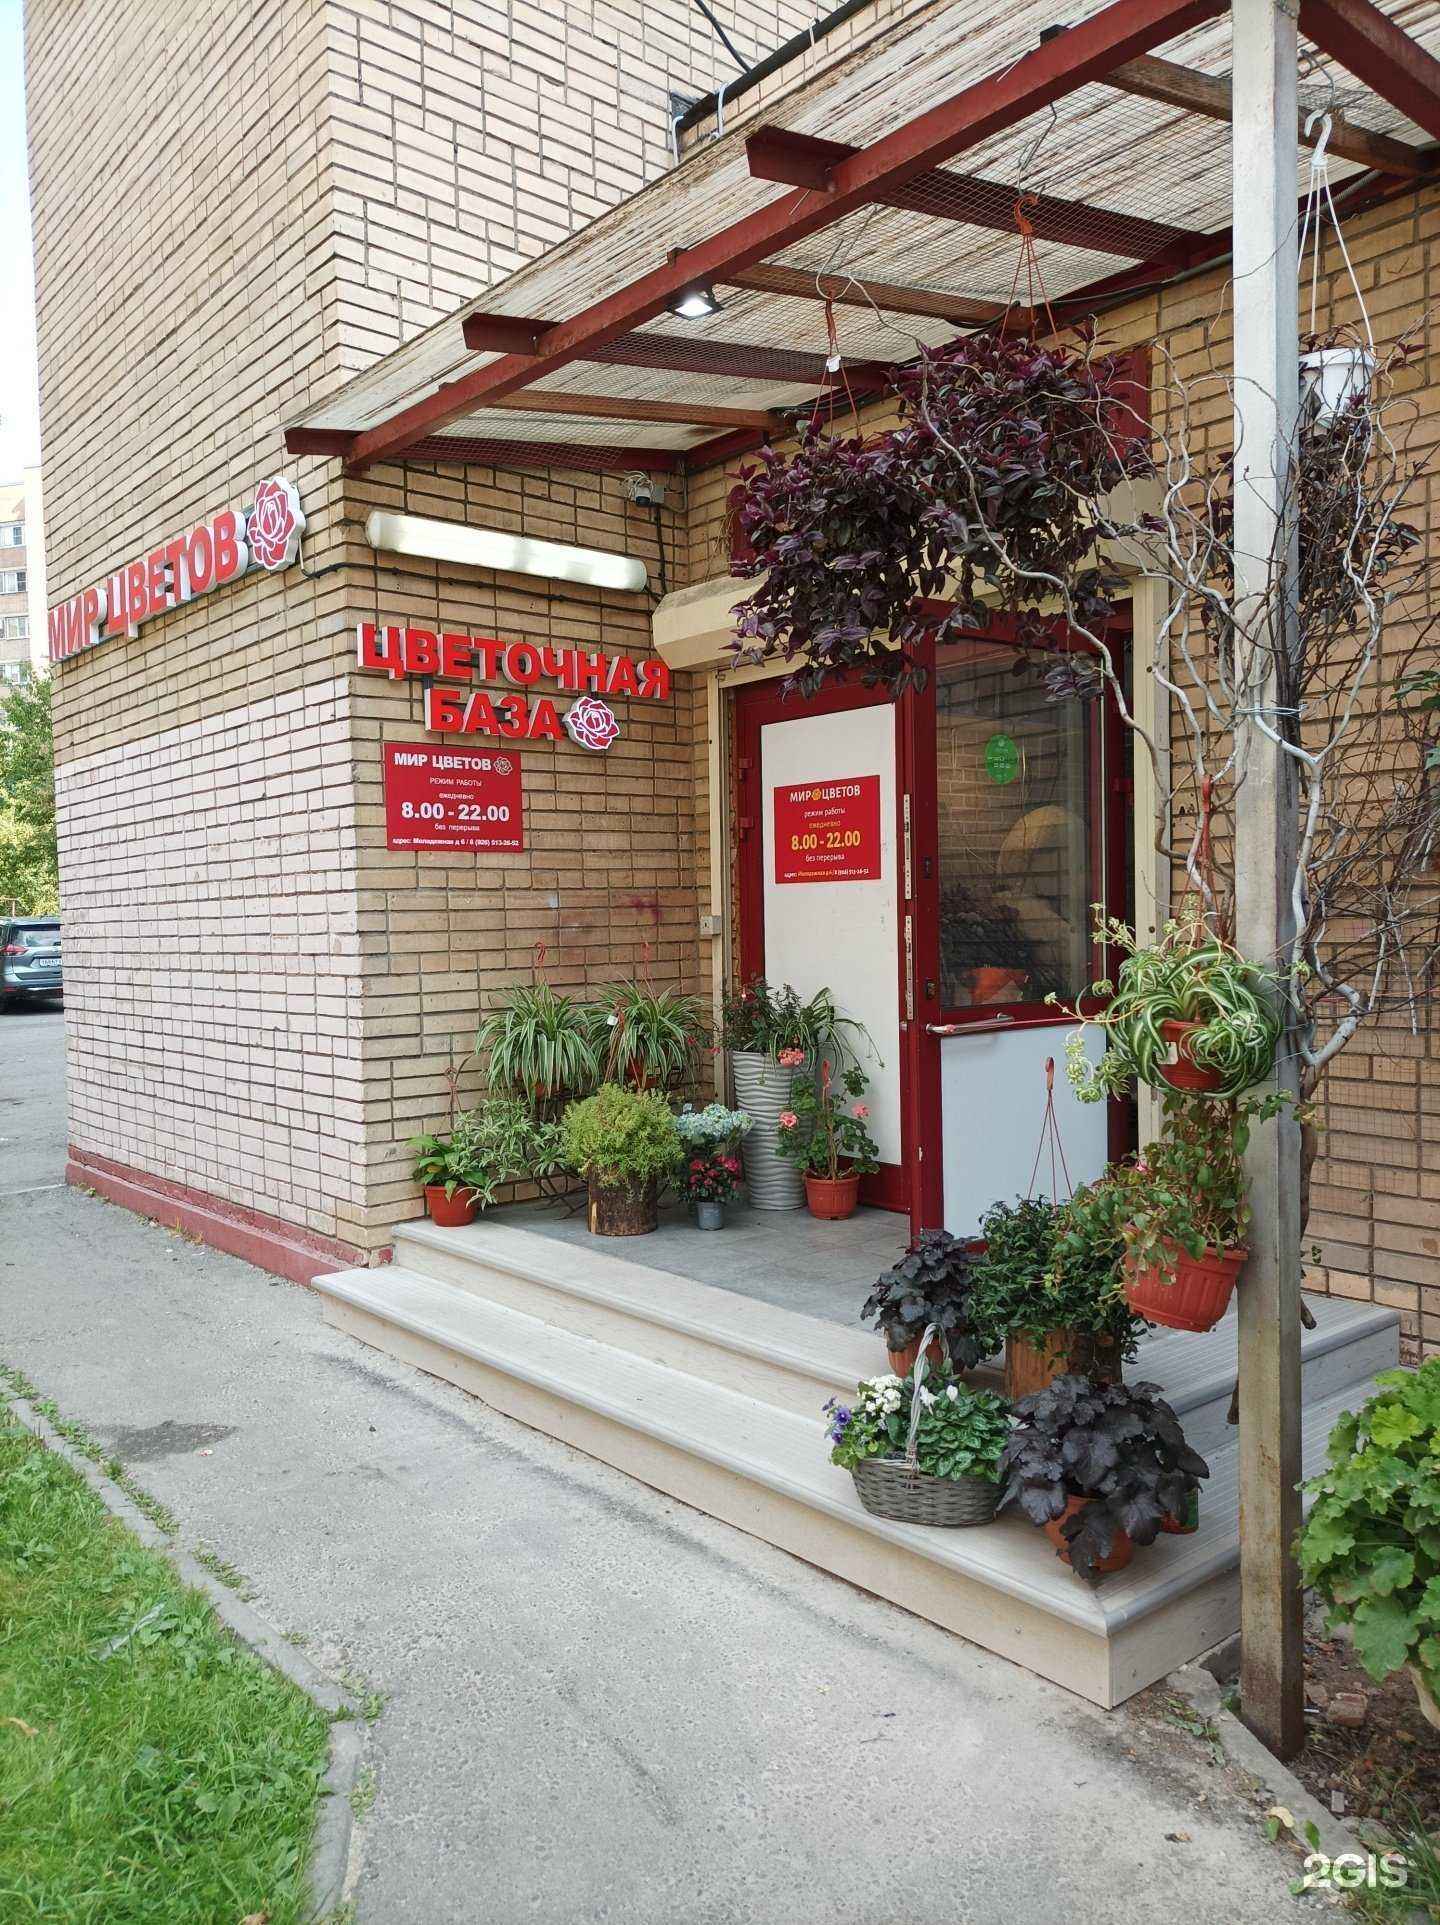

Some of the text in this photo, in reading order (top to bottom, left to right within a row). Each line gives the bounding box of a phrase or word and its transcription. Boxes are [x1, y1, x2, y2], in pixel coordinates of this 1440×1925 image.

[48, 510, 248, 662] МИР ЦВЕТОВ
[357, 622, 671, 700] ЦВЕТОЧНАЯ
[425, 688, 565, 742] БАЗА
[394, 752, 492, 771] МИР ЦВЕТОВ
[429, 777, 482, 787] РЕЖИМ РАБОТЫ
[789, 785, 861, 803] МИР ЦВЕТОВ
[401, 801, 445, 819] 8.00
[458, 804, 510, 822] 22.00
[824, 807, 846, 817] работы
[791, 833, 818, 851] 8.00
[826, 830, 861, 849] 22.00
